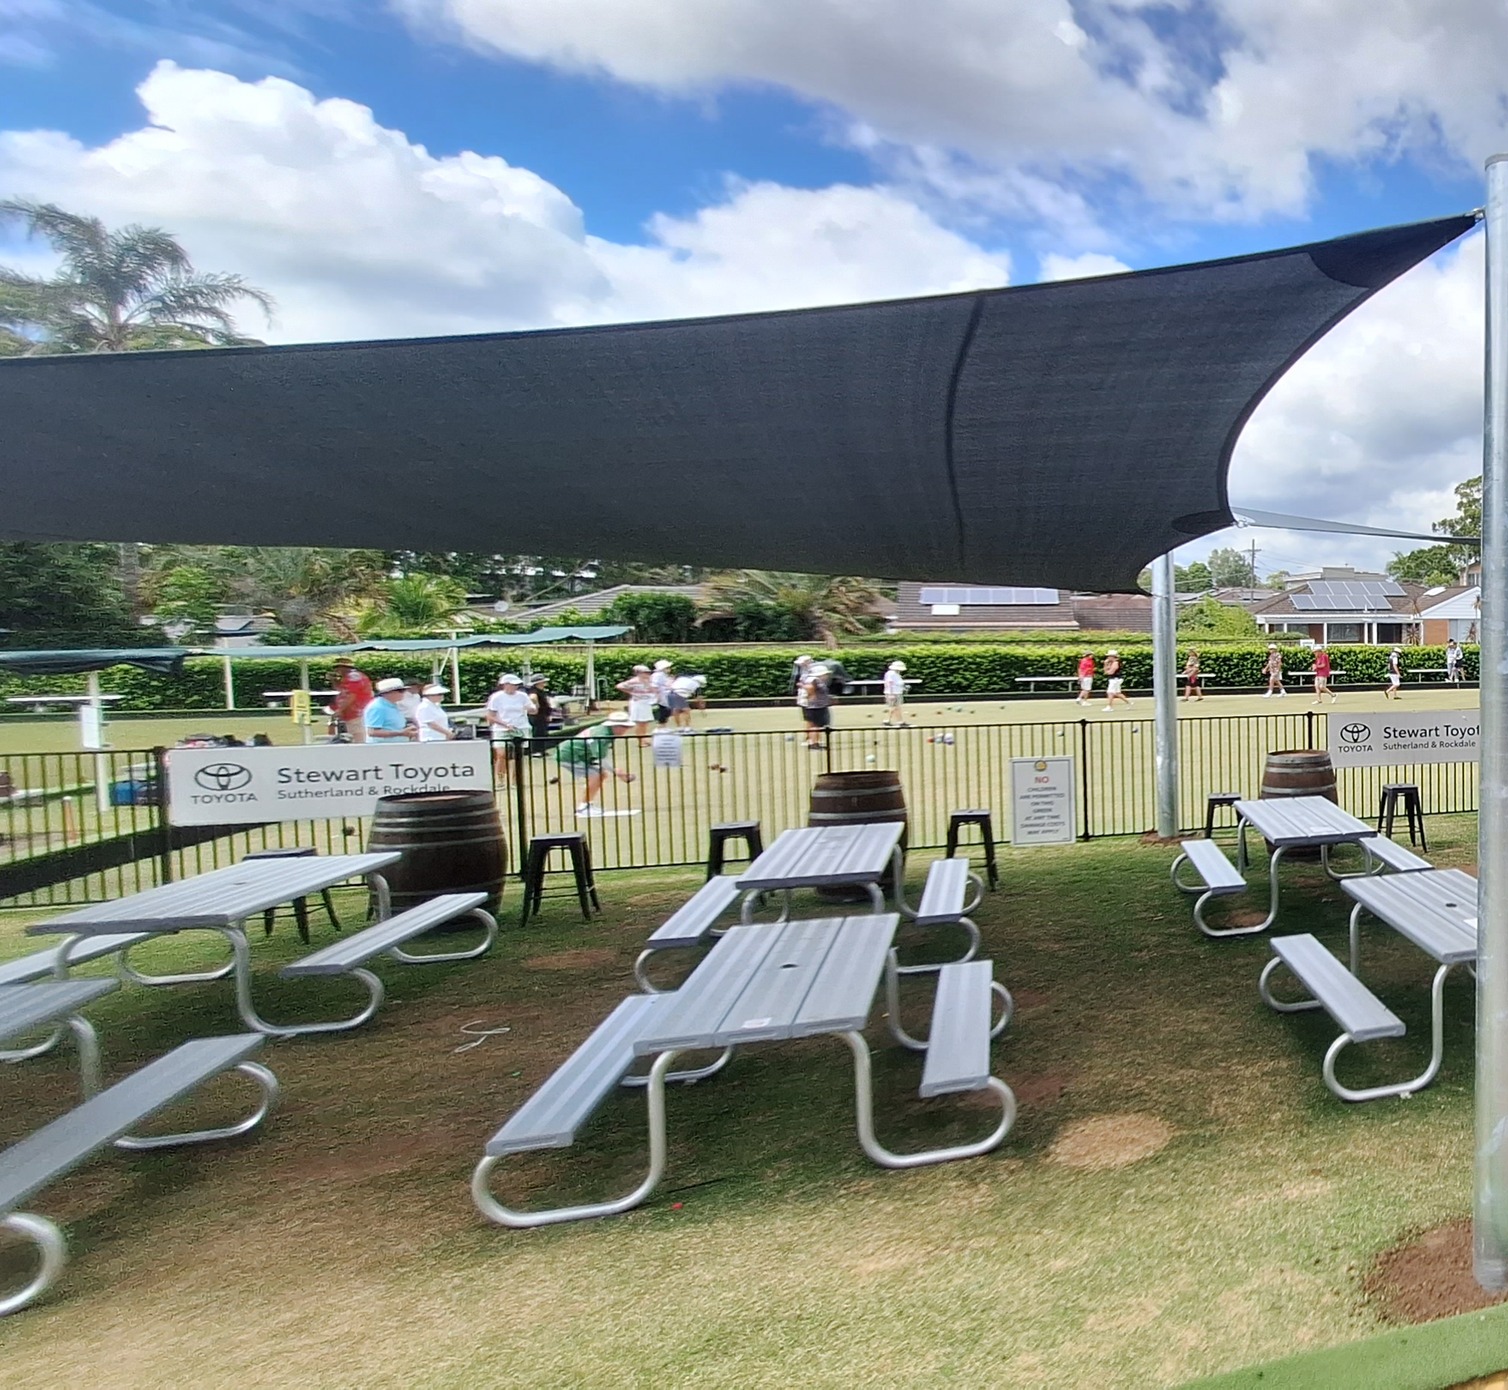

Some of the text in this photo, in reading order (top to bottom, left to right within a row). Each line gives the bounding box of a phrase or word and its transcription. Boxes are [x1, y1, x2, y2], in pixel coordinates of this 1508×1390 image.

[1383, 724, 1480, 739] Stewart Toyot
[1338, 745, 1374, 753] TOYOTA
[1383, 740, 1476, 750] Sutherland & Rockdale
[277, 763, 475, 784] Stewart Toyota
[277, 786, 364, 799] Sutherland
[368, 786, 379, 796] &
[191, 793, 258, 805] TOYOTA
